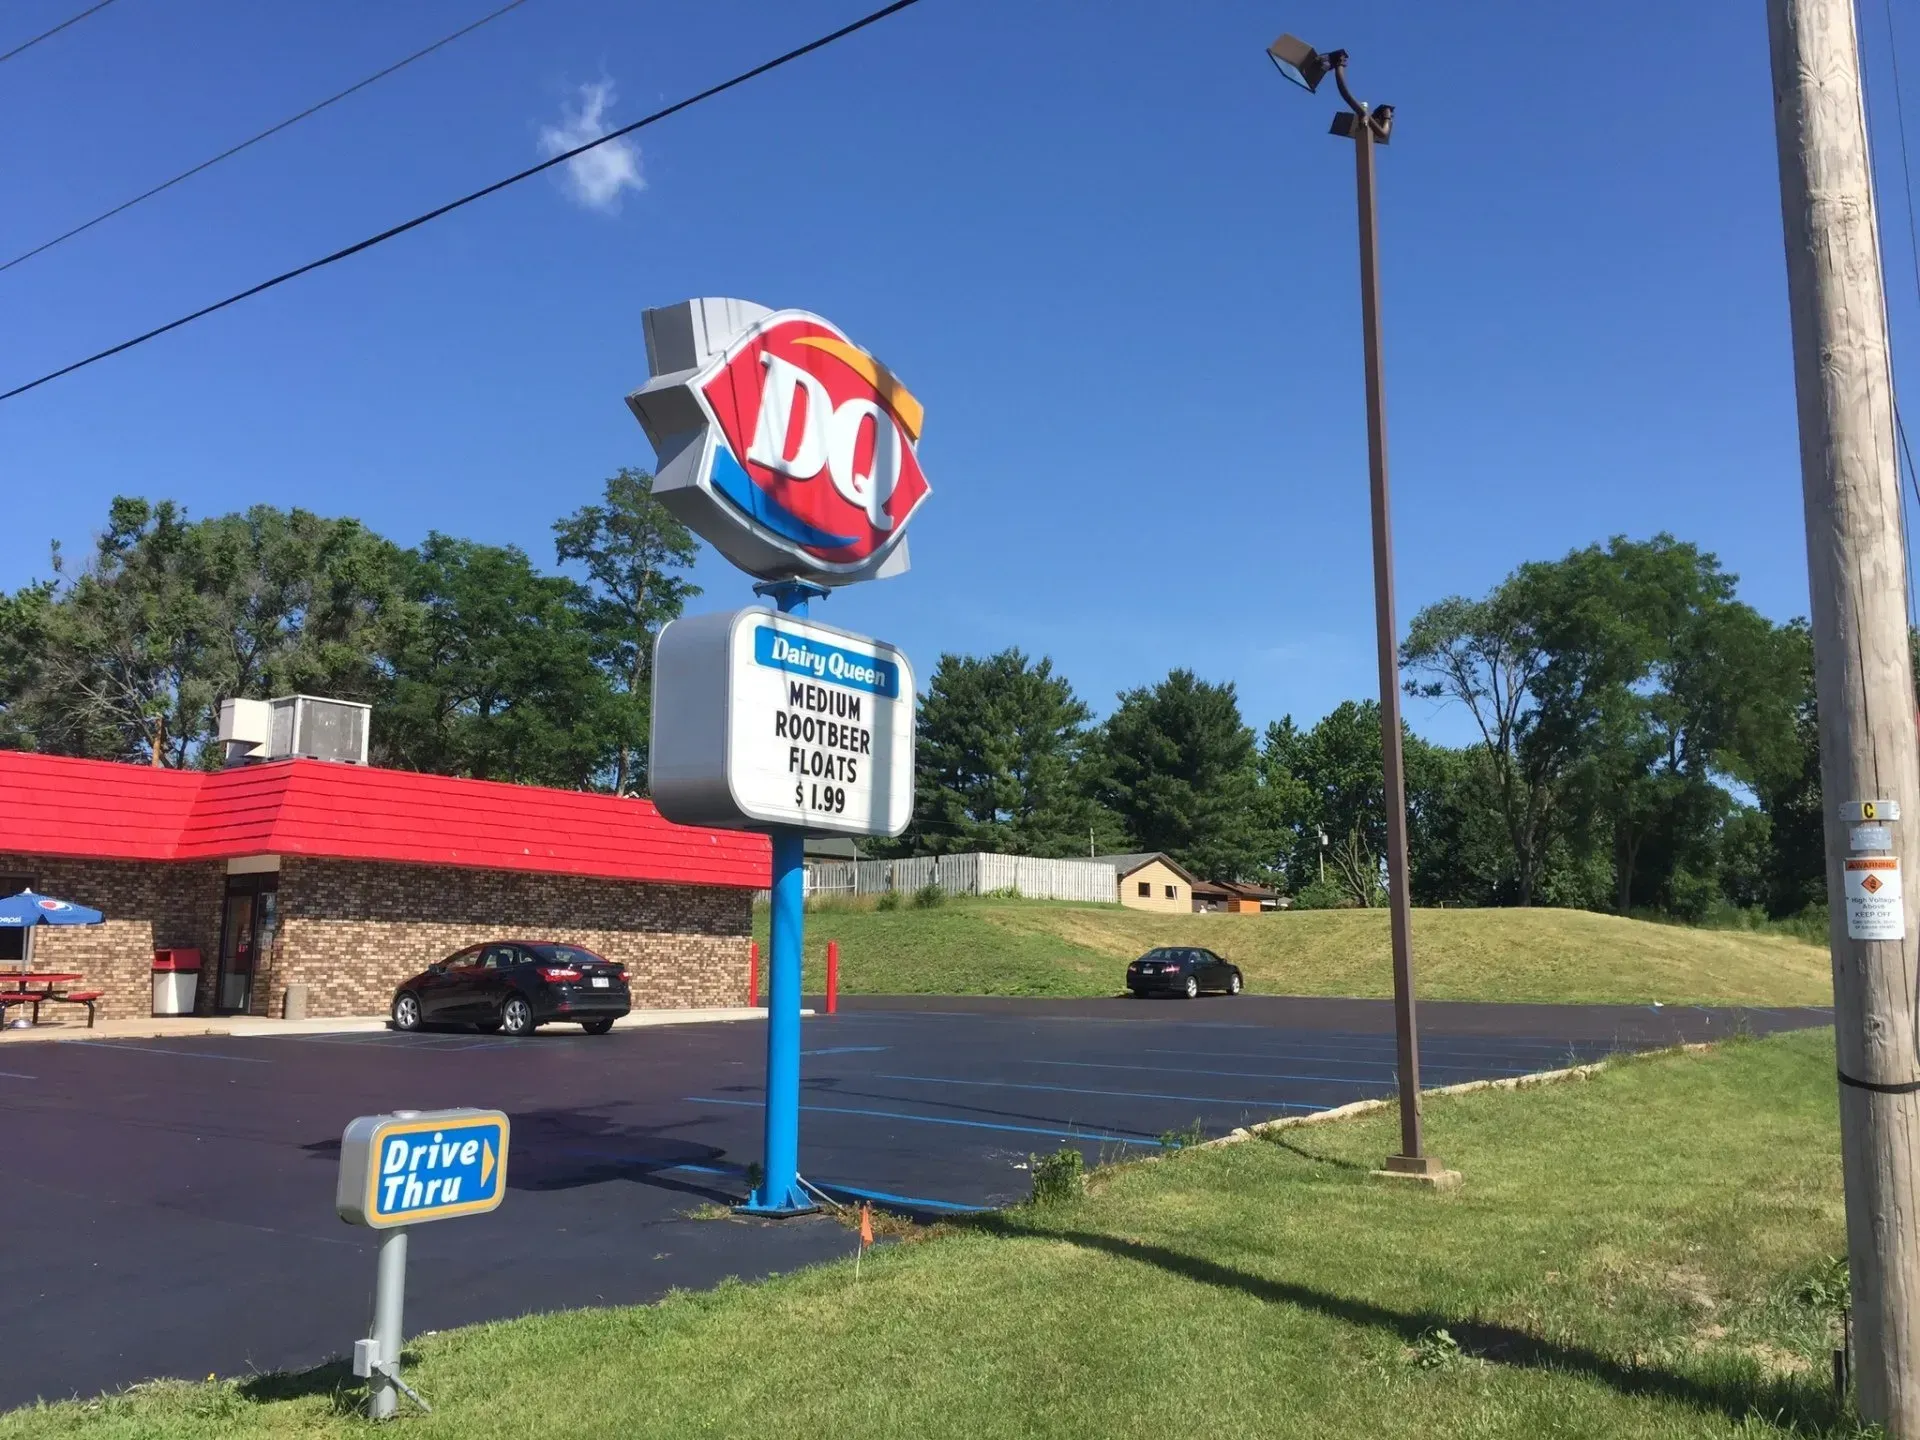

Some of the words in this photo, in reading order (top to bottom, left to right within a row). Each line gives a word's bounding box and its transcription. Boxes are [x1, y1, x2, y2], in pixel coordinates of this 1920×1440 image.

[746, 350, 902, 531] DQ
[771, 636, 826, 676] Dairy
[828, 652, 886, 687] Queen
[790, 681, 861, 721] MEDIUM
[775, 710, 870, 755] ROOTBEER
[789, 747, 857, 783] FLOATS
[1864, 802, 1874, 818] C
[383, 1132, 479, 1174] Drive
[383, 1172, 462, 1211] Thru
